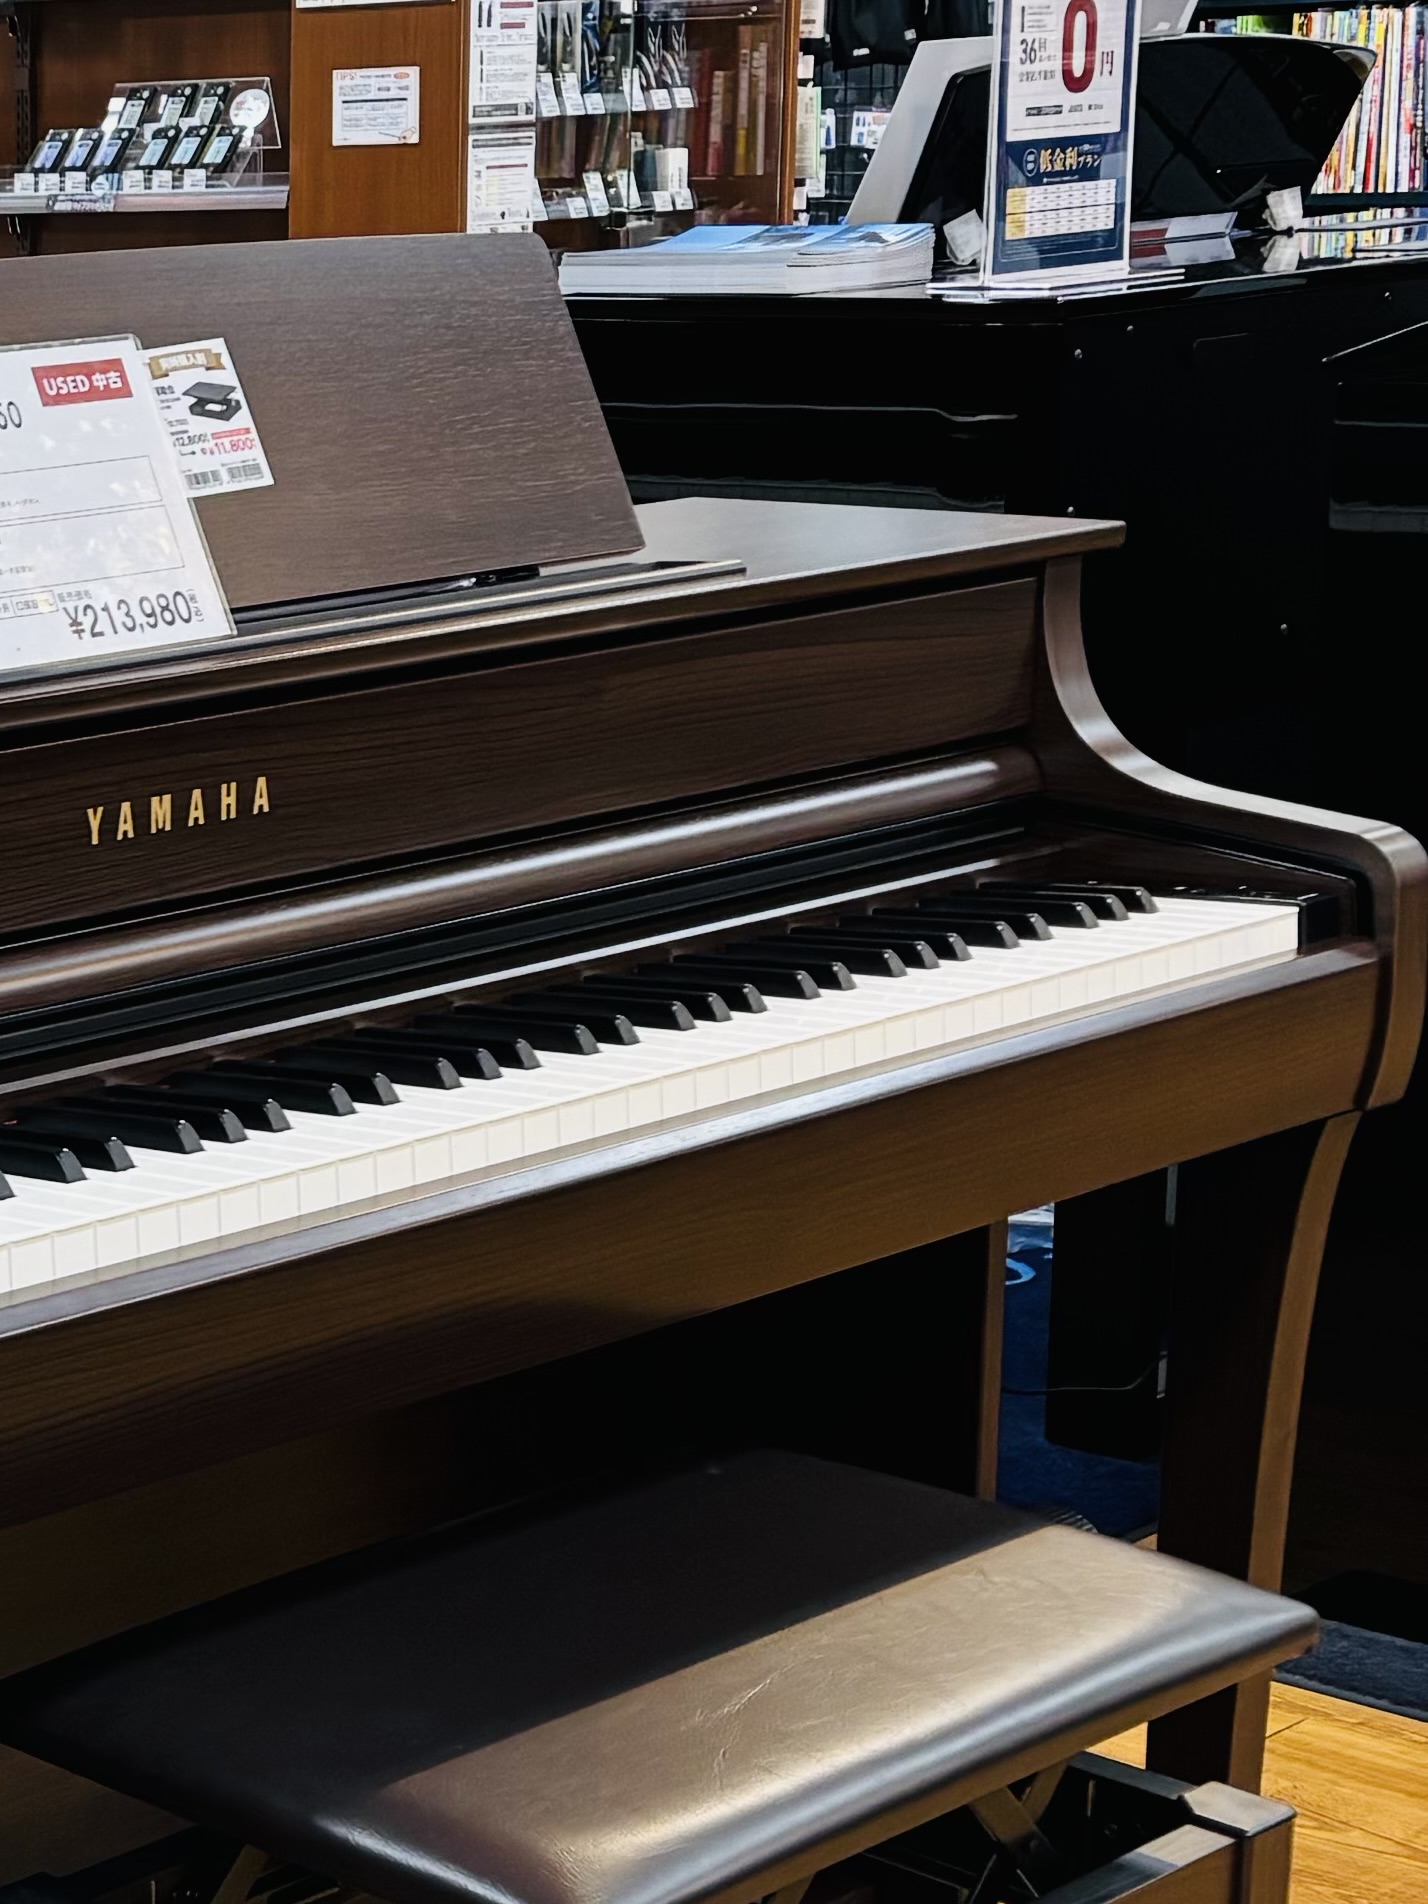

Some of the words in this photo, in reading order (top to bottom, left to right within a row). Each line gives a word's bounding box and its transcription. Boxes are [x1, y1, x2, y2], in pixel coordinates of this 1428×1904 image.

[41, 373, 91, 397] USED
[91, 370, 124, 393] 中古
[62, 590, 193, 641] ¥213,980
[86, 775, 271, 846] YAMAHA
